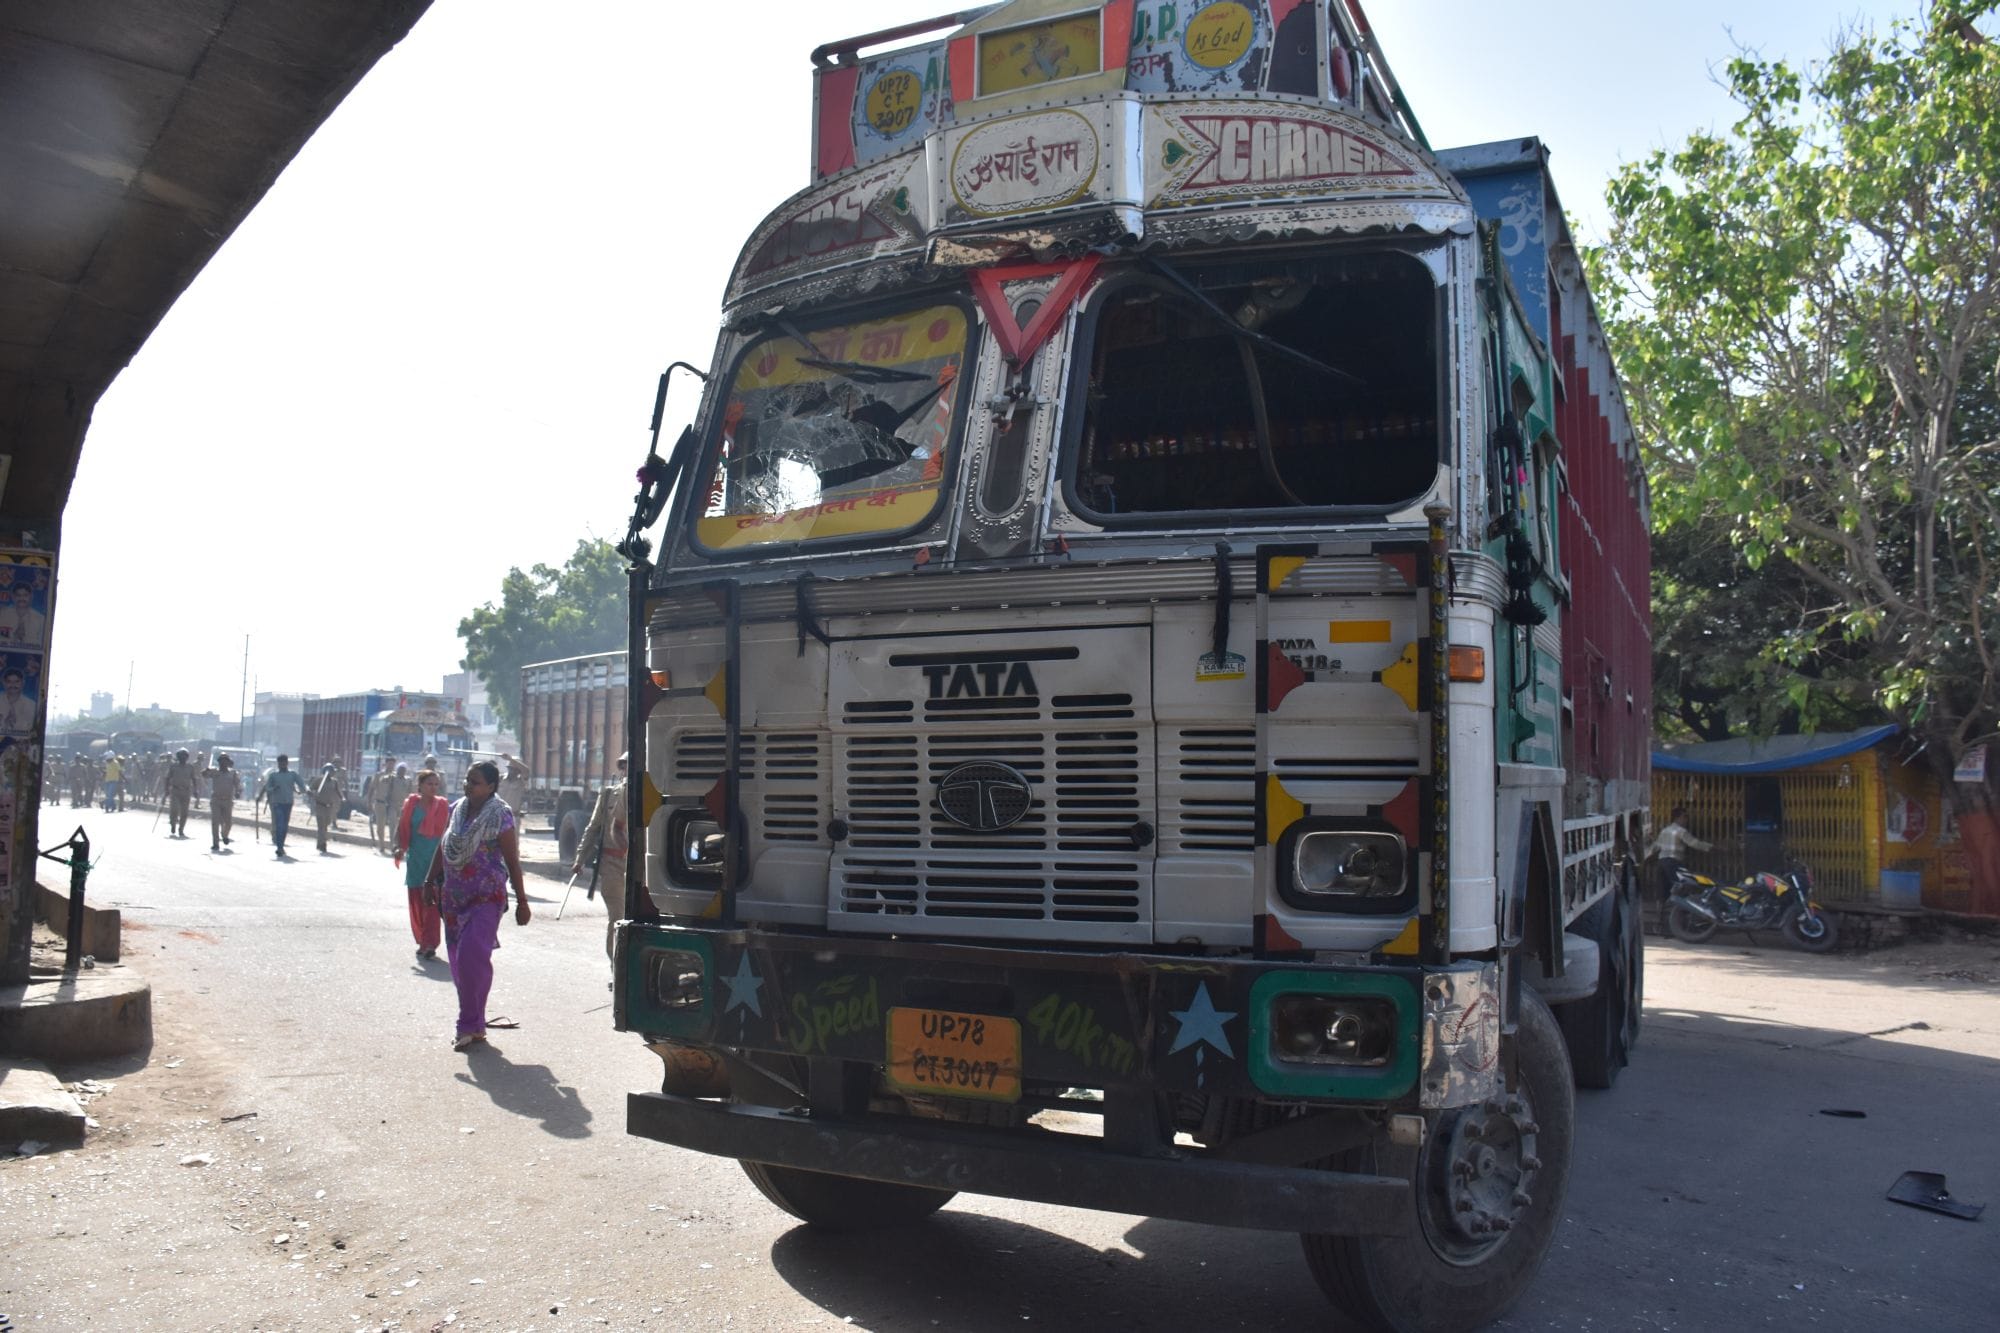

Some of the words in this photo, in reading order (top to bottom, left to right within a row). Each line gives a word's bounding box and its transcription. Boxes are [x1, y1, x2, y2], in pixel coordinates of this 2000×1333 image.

[1211, 22, 1245, 48] God
[1041, 140, 1082, 176] राम
[1218, 119, 1388, 181] CARRIER
[1276, 638, 1317, 650] TATA
[922, 662, 1039, 698] TATA
[1204, 662, 1236, 671] KAAL
[789, 976, 880, 1054] Speed
